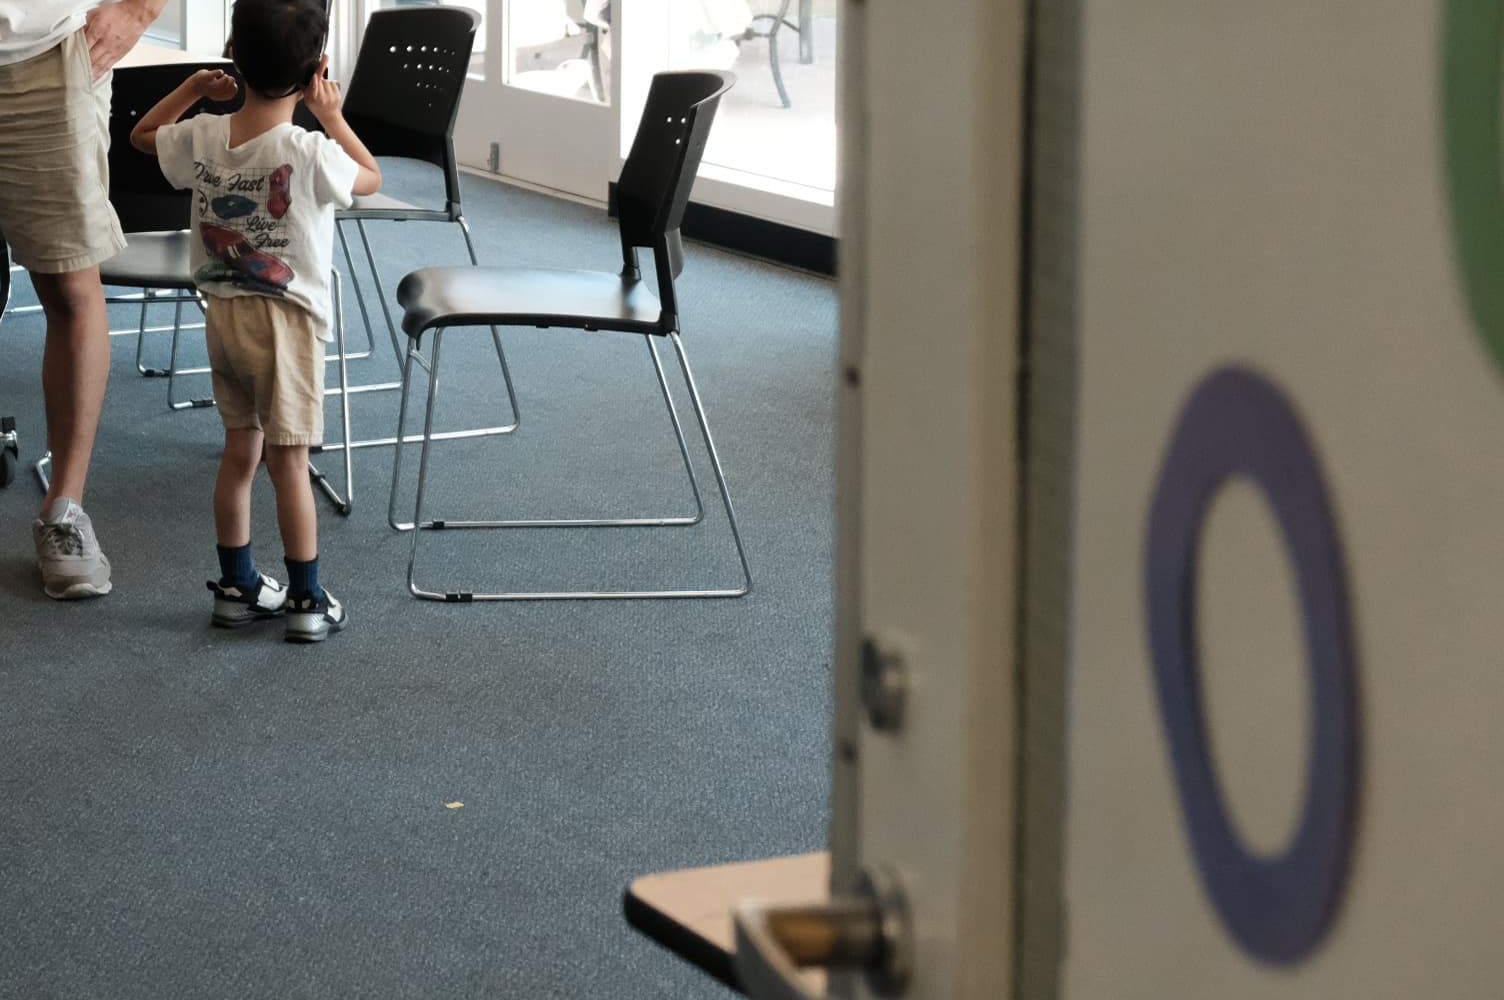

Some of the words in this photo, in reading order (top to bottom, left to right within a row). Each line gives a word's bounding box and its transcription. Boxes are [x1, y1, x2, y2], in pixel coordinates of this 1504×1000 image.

[227, 173, 265, 192] Fast
[245, 215, 277, 232] Live
[255, 232, 290, 249] Free
